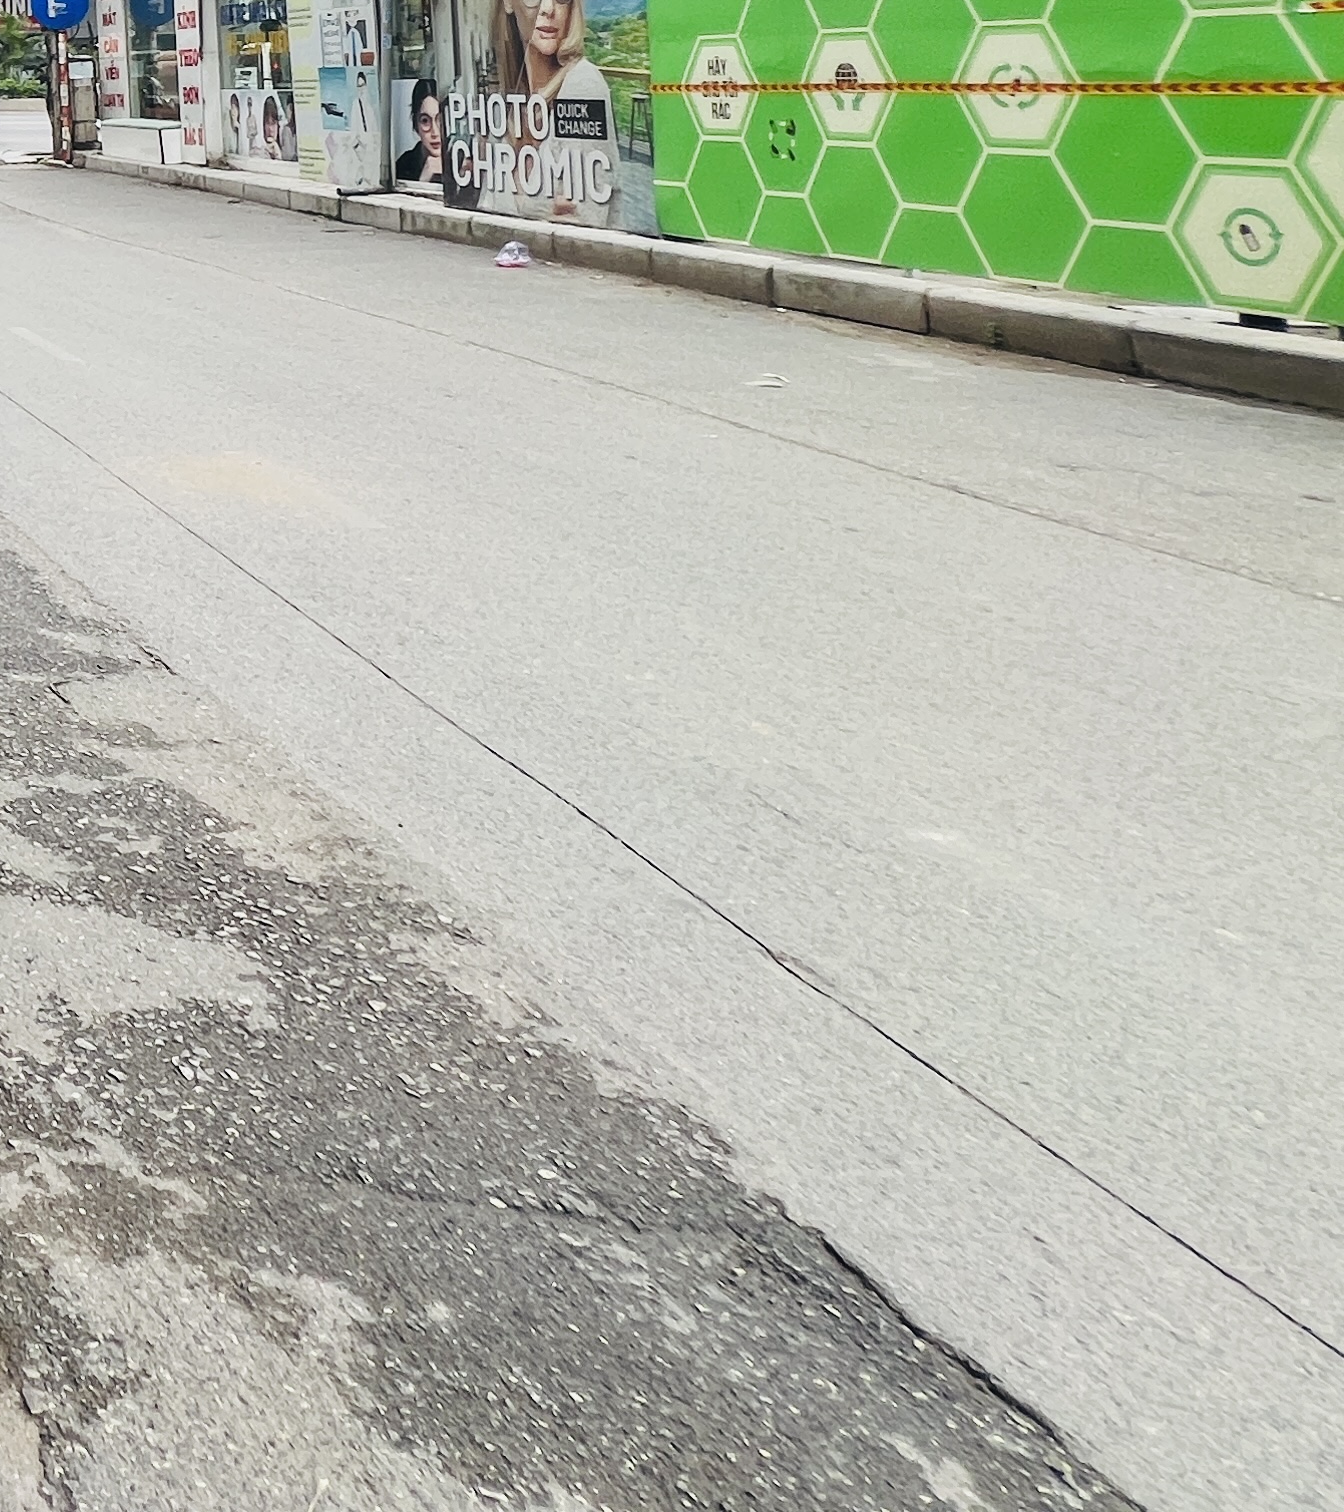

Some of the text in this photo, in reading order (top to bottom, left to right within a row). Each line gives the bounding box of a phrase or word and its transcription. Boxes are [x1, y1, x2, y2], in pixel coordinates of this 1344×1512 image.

[448, 92, 549, 140] PHOTO
[556, 103, 589, 119] QUICK
[711, 99, 731, 120] RÁC
[557, 120, 603, 137] CHANGE
[451, 140, 613, 204] CHROMIC
